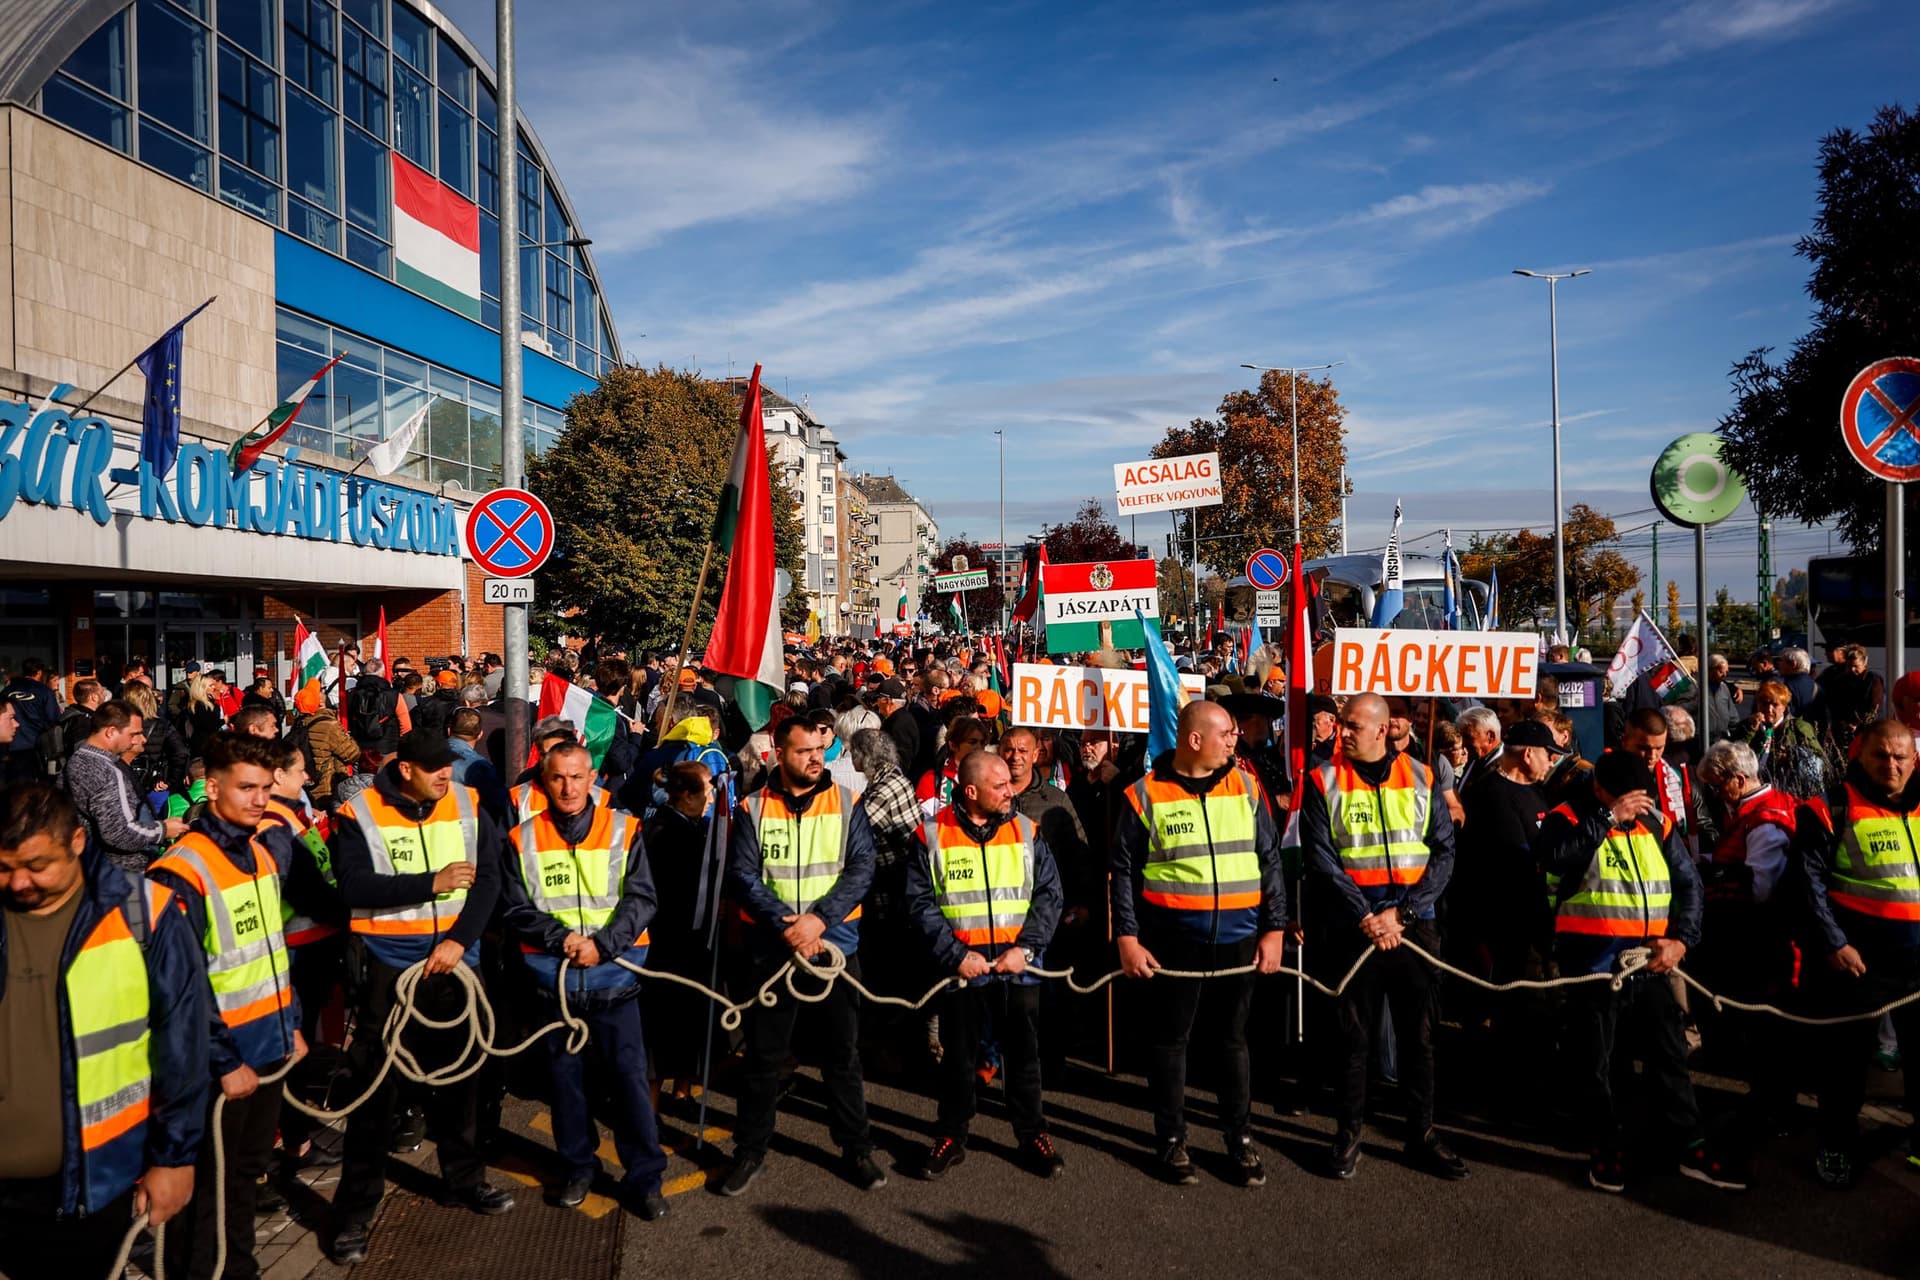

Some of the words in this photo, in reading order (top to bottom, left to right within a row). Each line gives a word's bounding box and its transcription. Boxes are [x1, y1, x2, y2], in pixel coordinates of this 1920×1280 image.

[1123, 458, 1212, 487] ACSALAG
[1119, 492, 1165, 508] VELETEK
[1167, 486, 1221, 503] VAGYUNK
[348, 478, 461, 556] USZODA
[492, 585, 509, 598] 20
[514, 587, 528, 598] m
[1056, 595, 1151, 618] JÁSZAPÁTI
[1260, 617, 1268, 625] 15
[1338, 632, 1535, 695] RÁCKEVE
[1166, 822, 1196, 837] H092
[1870, 838, 1901, 854] H248
[545, 873, 571, 888] C188
[948, 868, 974, 881] H242
